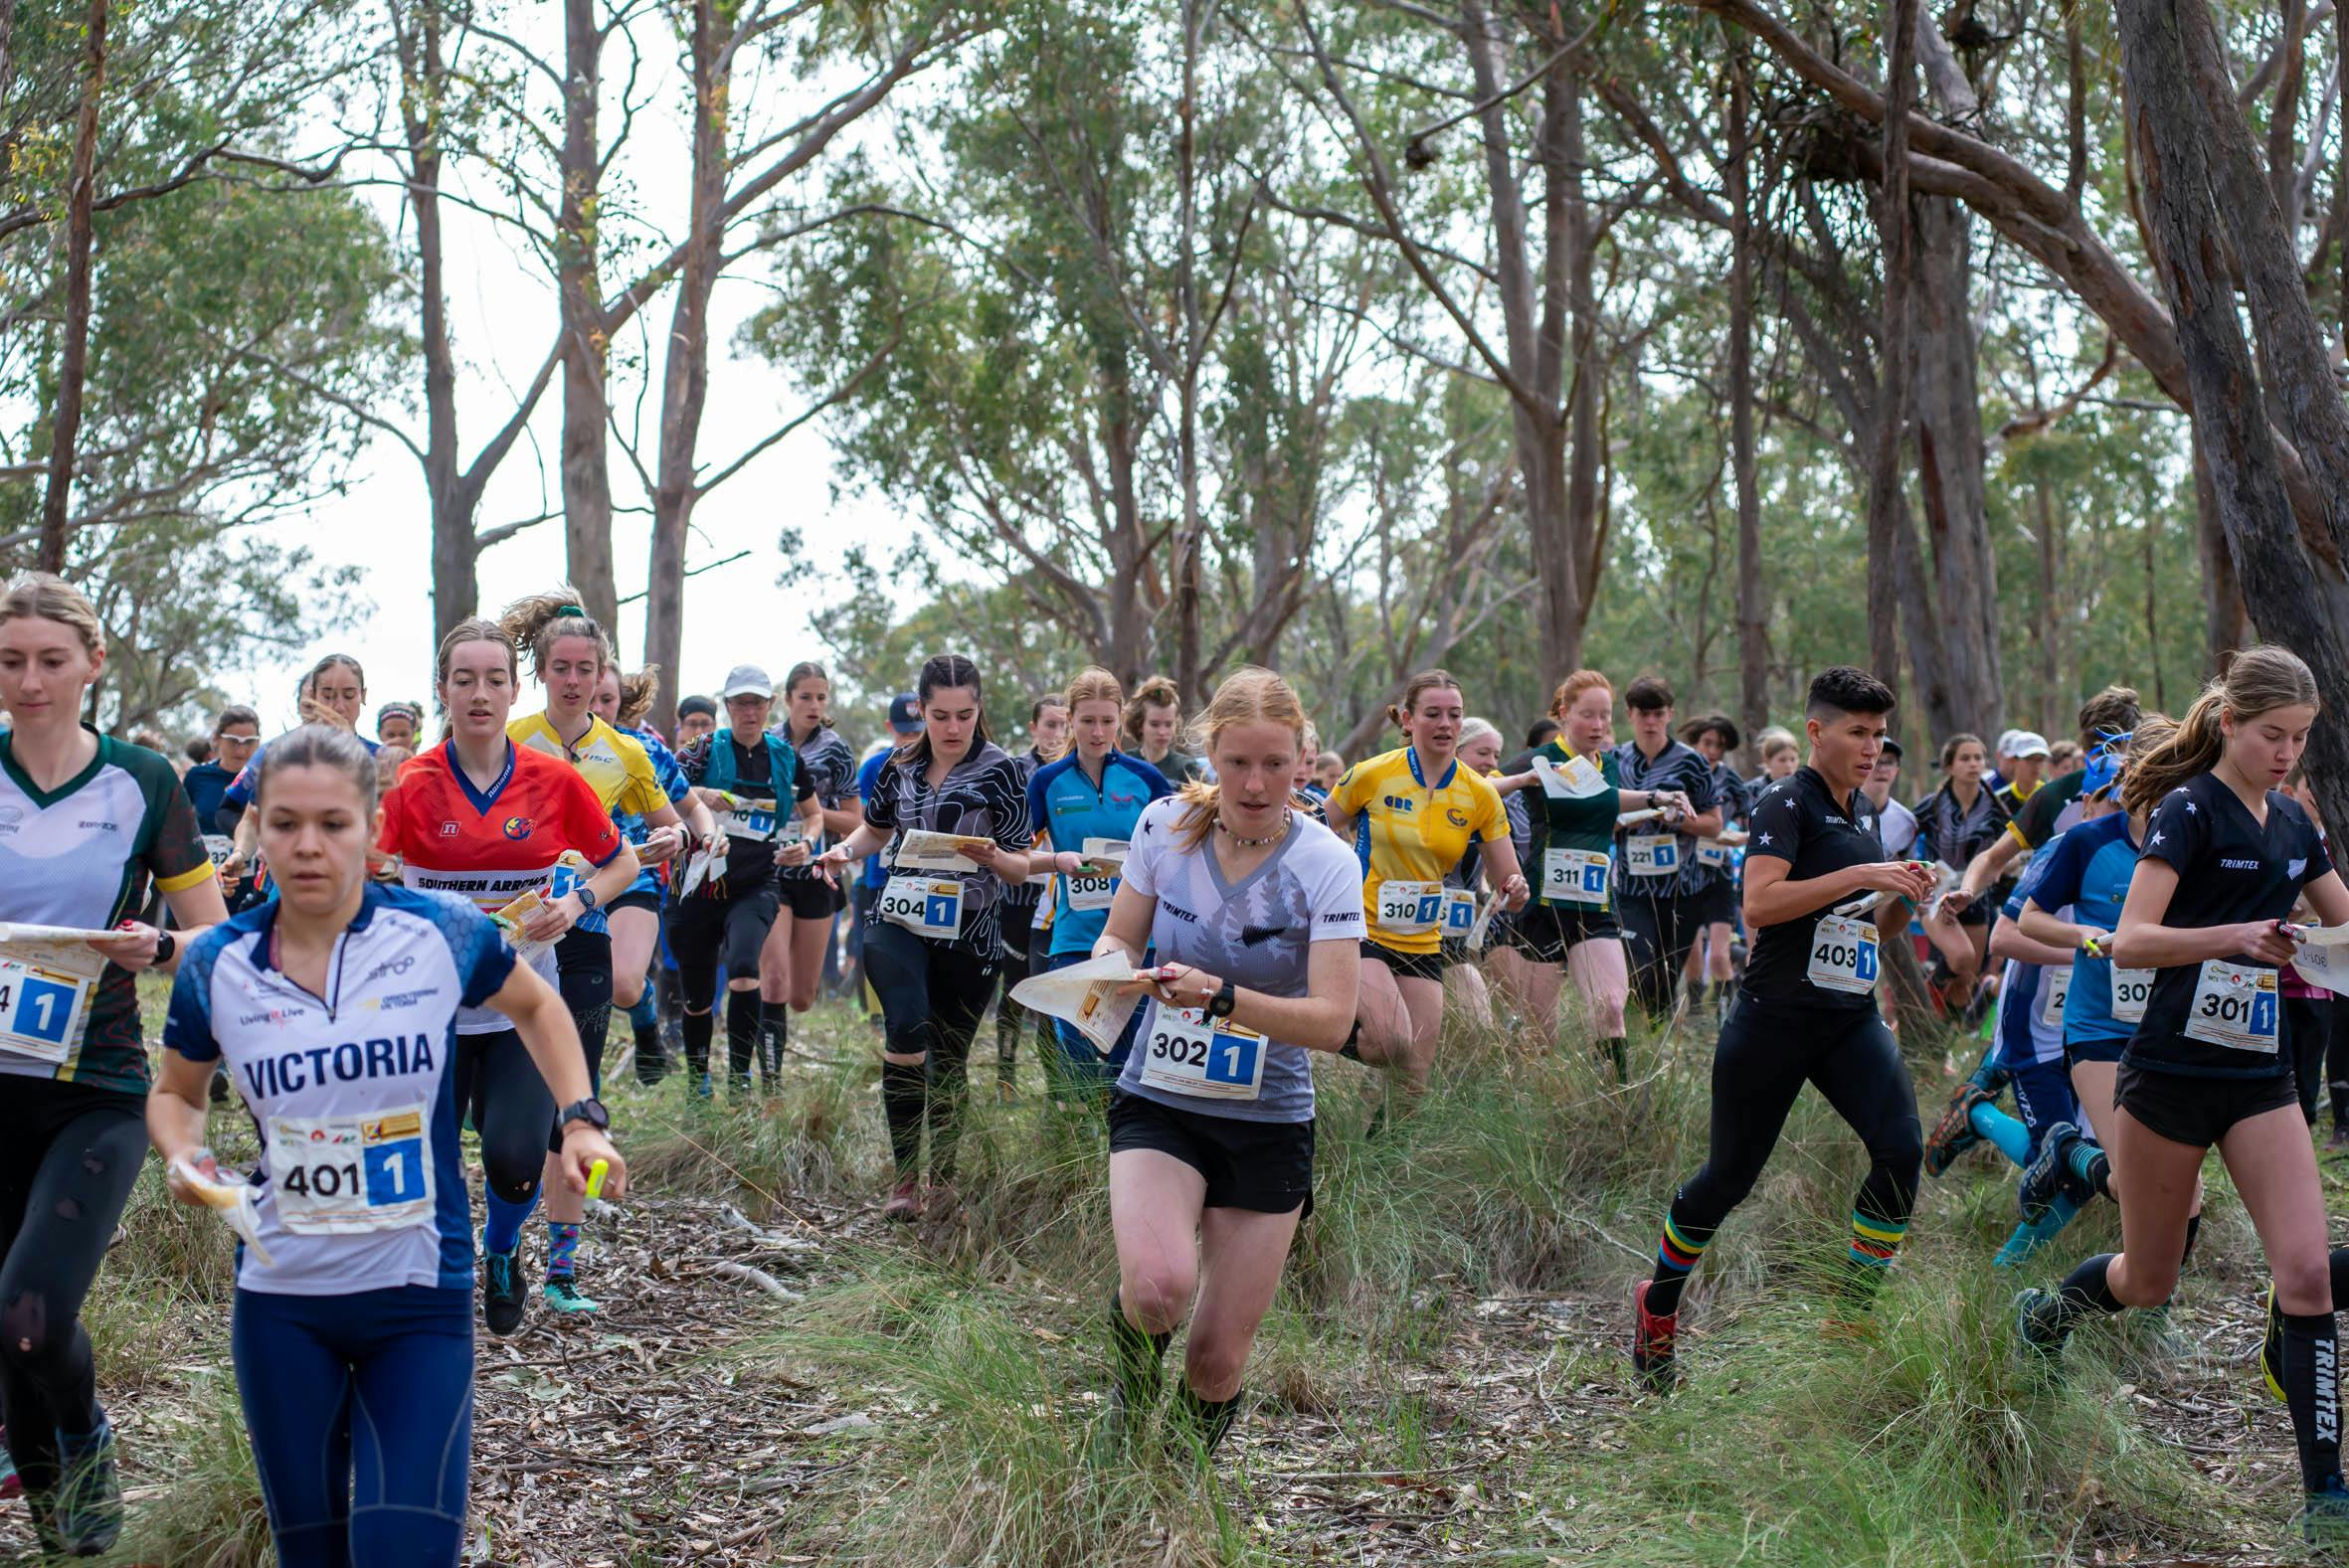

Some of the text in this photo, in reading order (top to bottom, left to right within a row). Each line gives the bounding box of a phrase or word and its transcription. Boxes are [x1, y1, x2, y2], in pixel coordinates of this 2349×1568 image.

[589, 754, 614, 765] ISC
[487, 764, 512, 798] noname
[1631, 849, 1668, 863] 221 1
[2220, 858, 2259, 870] TRIMTEX
[418, 877, 487, 893] SOUTHERN
[1070, 876, 1110, 895] 308
[1553, 868, 1599, 889] 311 1
[882, 896, 947, 923] 304 1
[1162, 900, 1198, 924] TRIMTEX
[1323, 911, 1360, 924] TRIMTEX
[1383, 902, 1416, 919] 310
[1423, 900, 1435, 921] 1
[1456, 907, 1466, 924] 1
[1814, 943, 1871, 975] 403 1
[34, 992, 56, 1032] 1
[2201, 993, 2268, 1030] 301 1
[244, 1033, 435, 1100] VICTORIA
[1152, 1032, 1241, 1078] 302 1
[283, 1151, 405, 1198] 401 1
[2314, 1338, 2338, 1444] TRIMTEX
